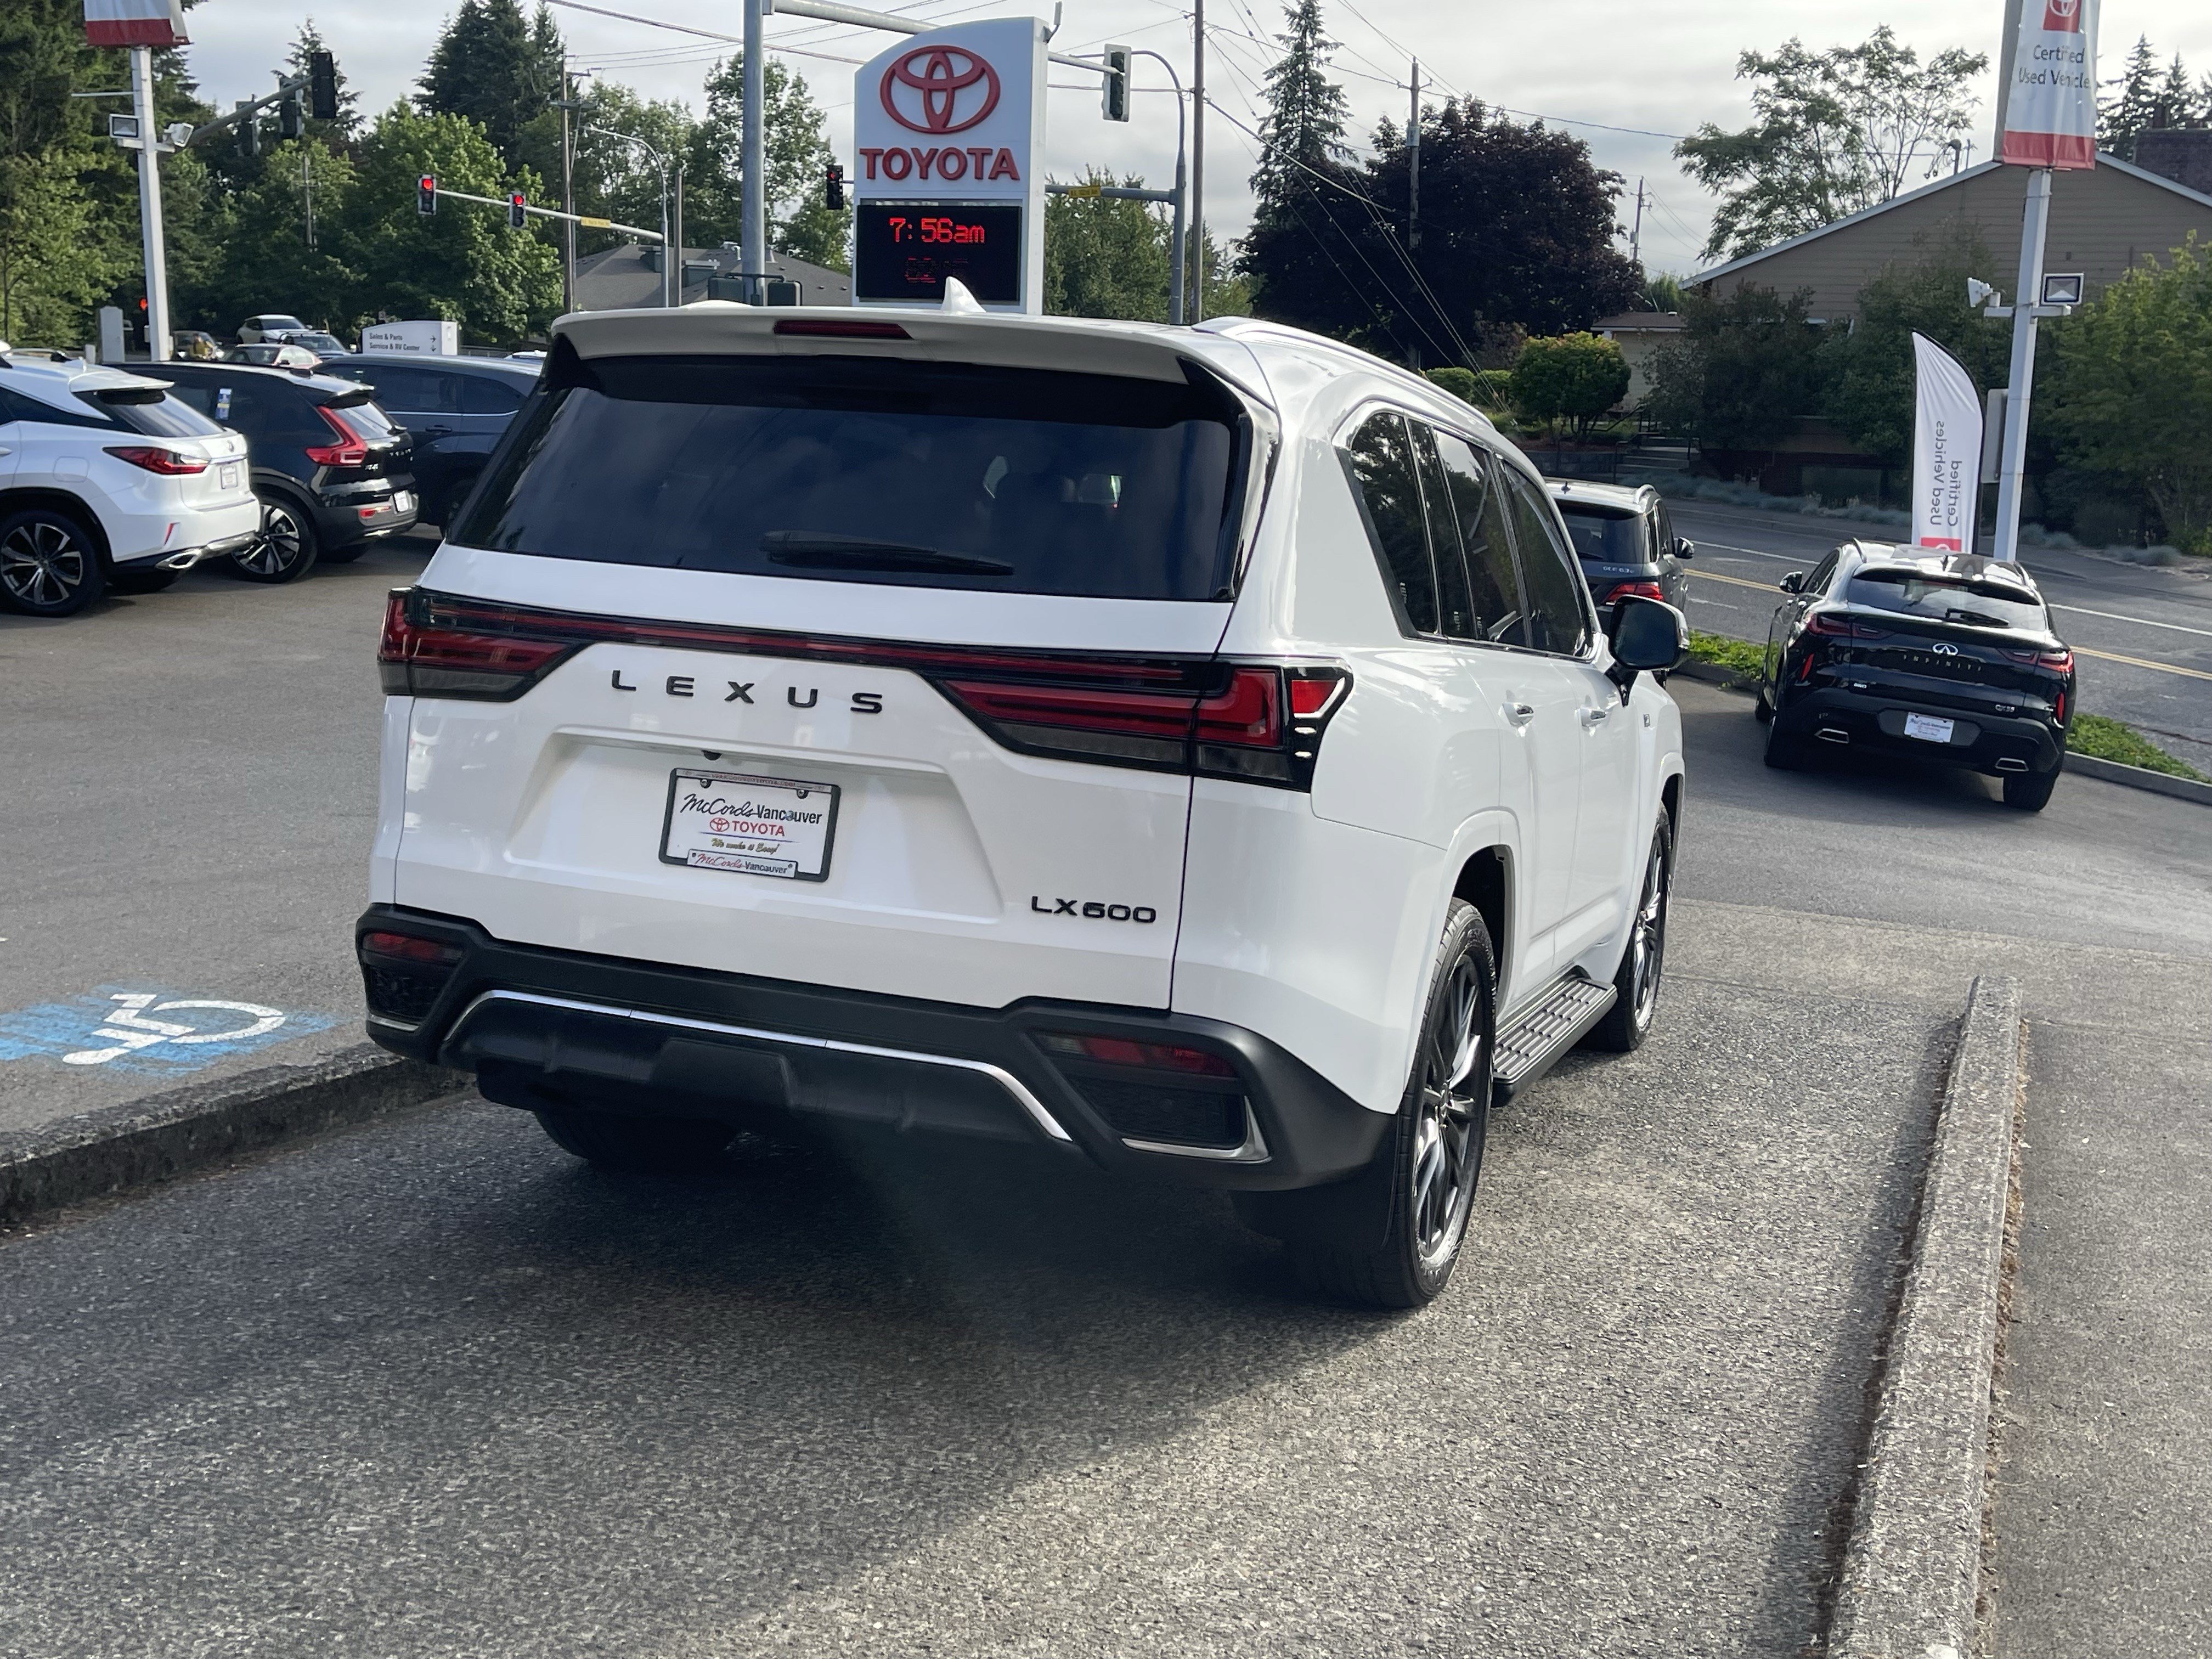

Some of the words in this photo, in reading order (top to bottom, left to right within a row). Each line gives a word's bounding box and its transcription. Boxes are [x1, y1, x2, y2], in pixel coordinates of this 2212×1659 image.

[2033, 44, 2085, 64] Certied
[2019, 66, 2047, 84] Used
[859, 146, 1020, 180] TOYOTA
[612, 670, 882, 714] LEXUS
[732, 821, 785, 837] TOYOTA
